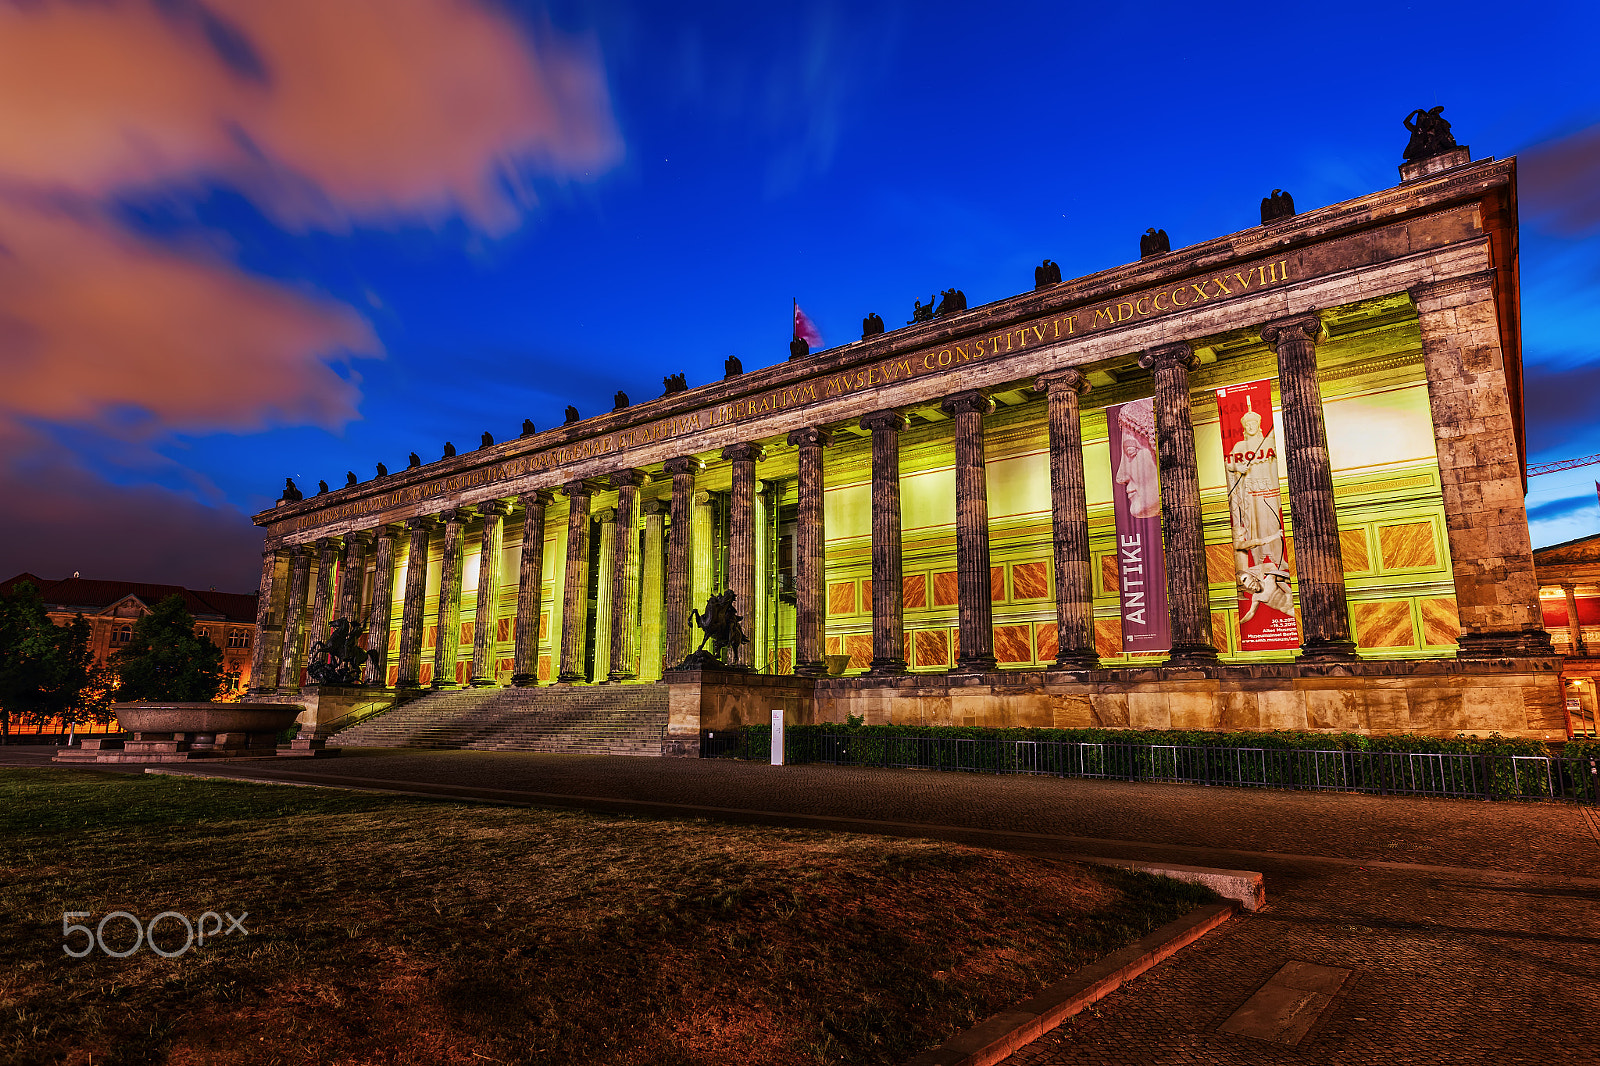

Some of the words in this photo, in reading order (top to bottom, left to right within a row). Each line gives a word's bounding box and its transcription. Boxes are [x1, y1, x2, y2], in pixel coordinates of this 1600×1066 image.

[618, 431, 637, 449] ET
[641, 415, 701, 442] ARTIVM
[709, 384, 817, 426] LIBERALIVM
[826, 361, 912, 396] MVSEVM
[923, 315, 1079, 370] CONSTITVIT
[1092, 260, 1289, 328] MDCCCXXVIII
[1224, 448, 1276, 464] TROJA
[1120, 533, 1146, 625] ANTIKE
